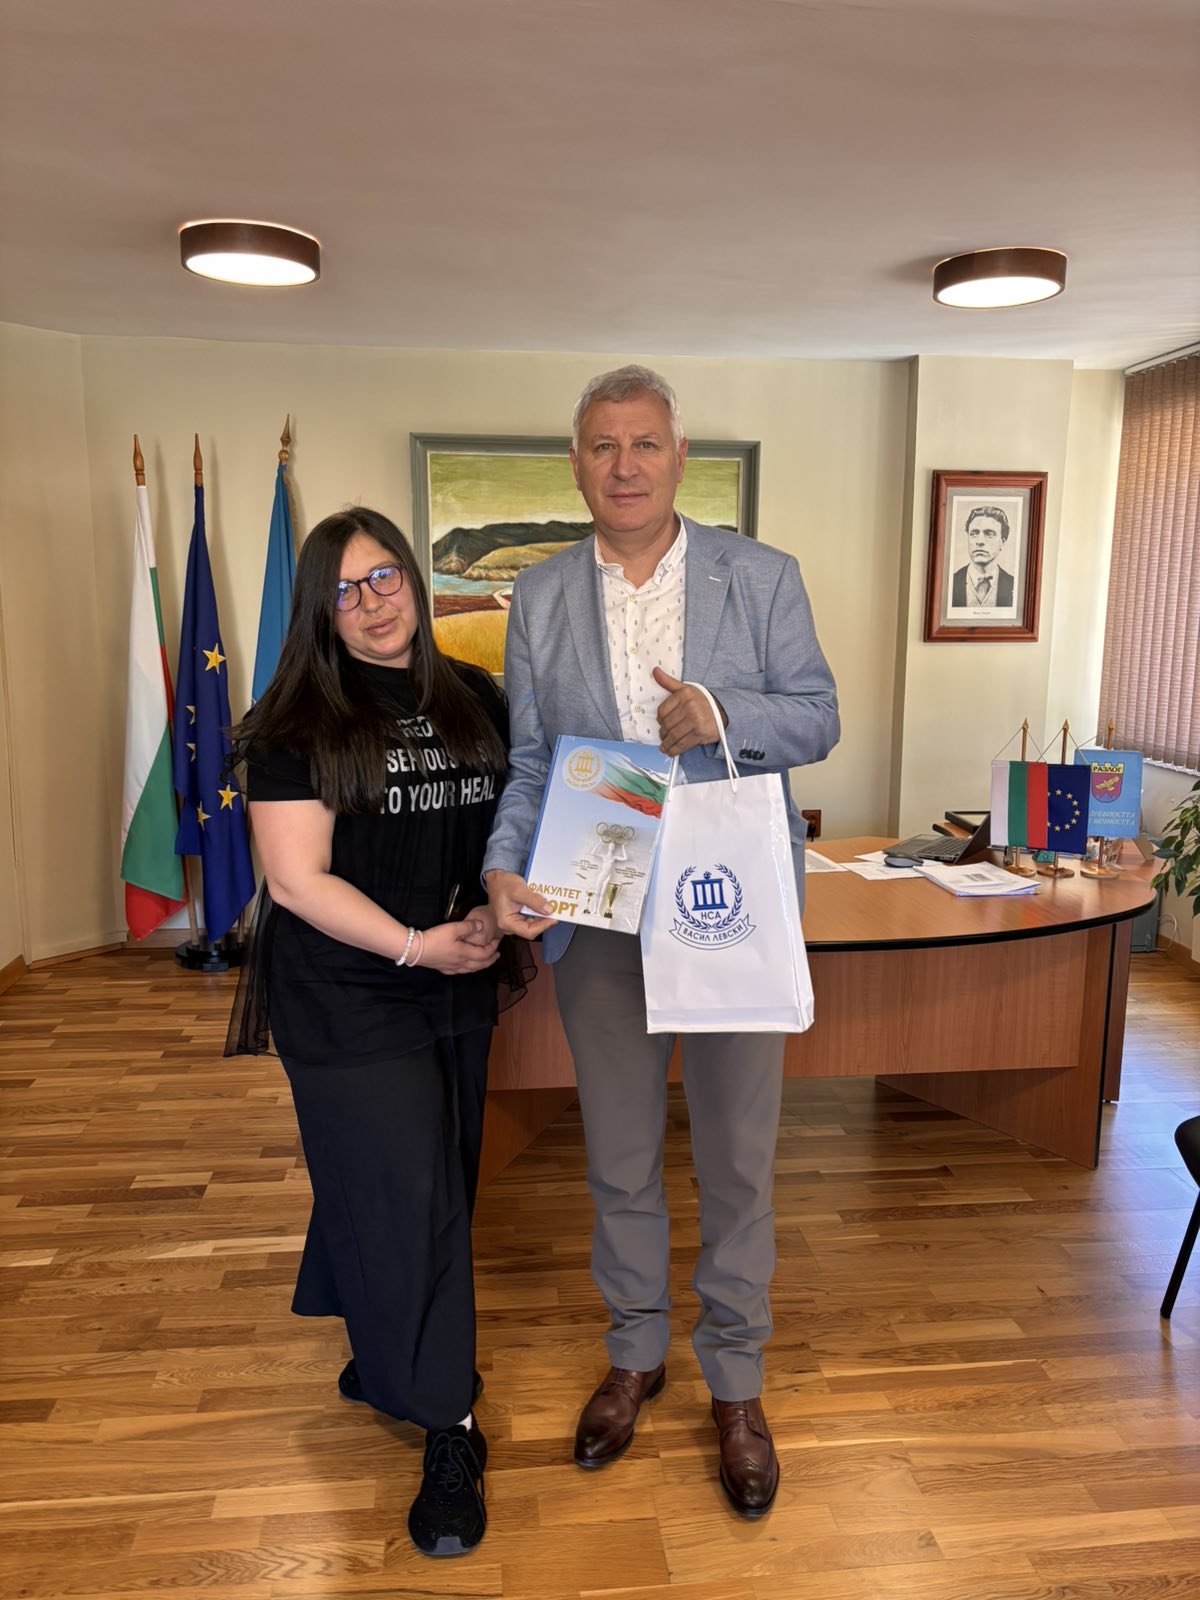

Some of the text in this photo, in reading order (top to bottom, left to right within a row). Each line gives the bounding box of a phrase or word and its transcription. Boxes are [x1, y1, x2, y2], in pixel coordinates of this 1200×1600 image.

[386, 747, 459, 773] SEOU
[408, 780, 456, 812] YOUR
[529, 882, 581, 900] ФАКУЛТЕТ
[545, 898, 578, 917] ОРТ
[701, 911, 721, 920] НСА
[682, 923, 744, 942] ВАСИЛ ЛЕВСКИ
